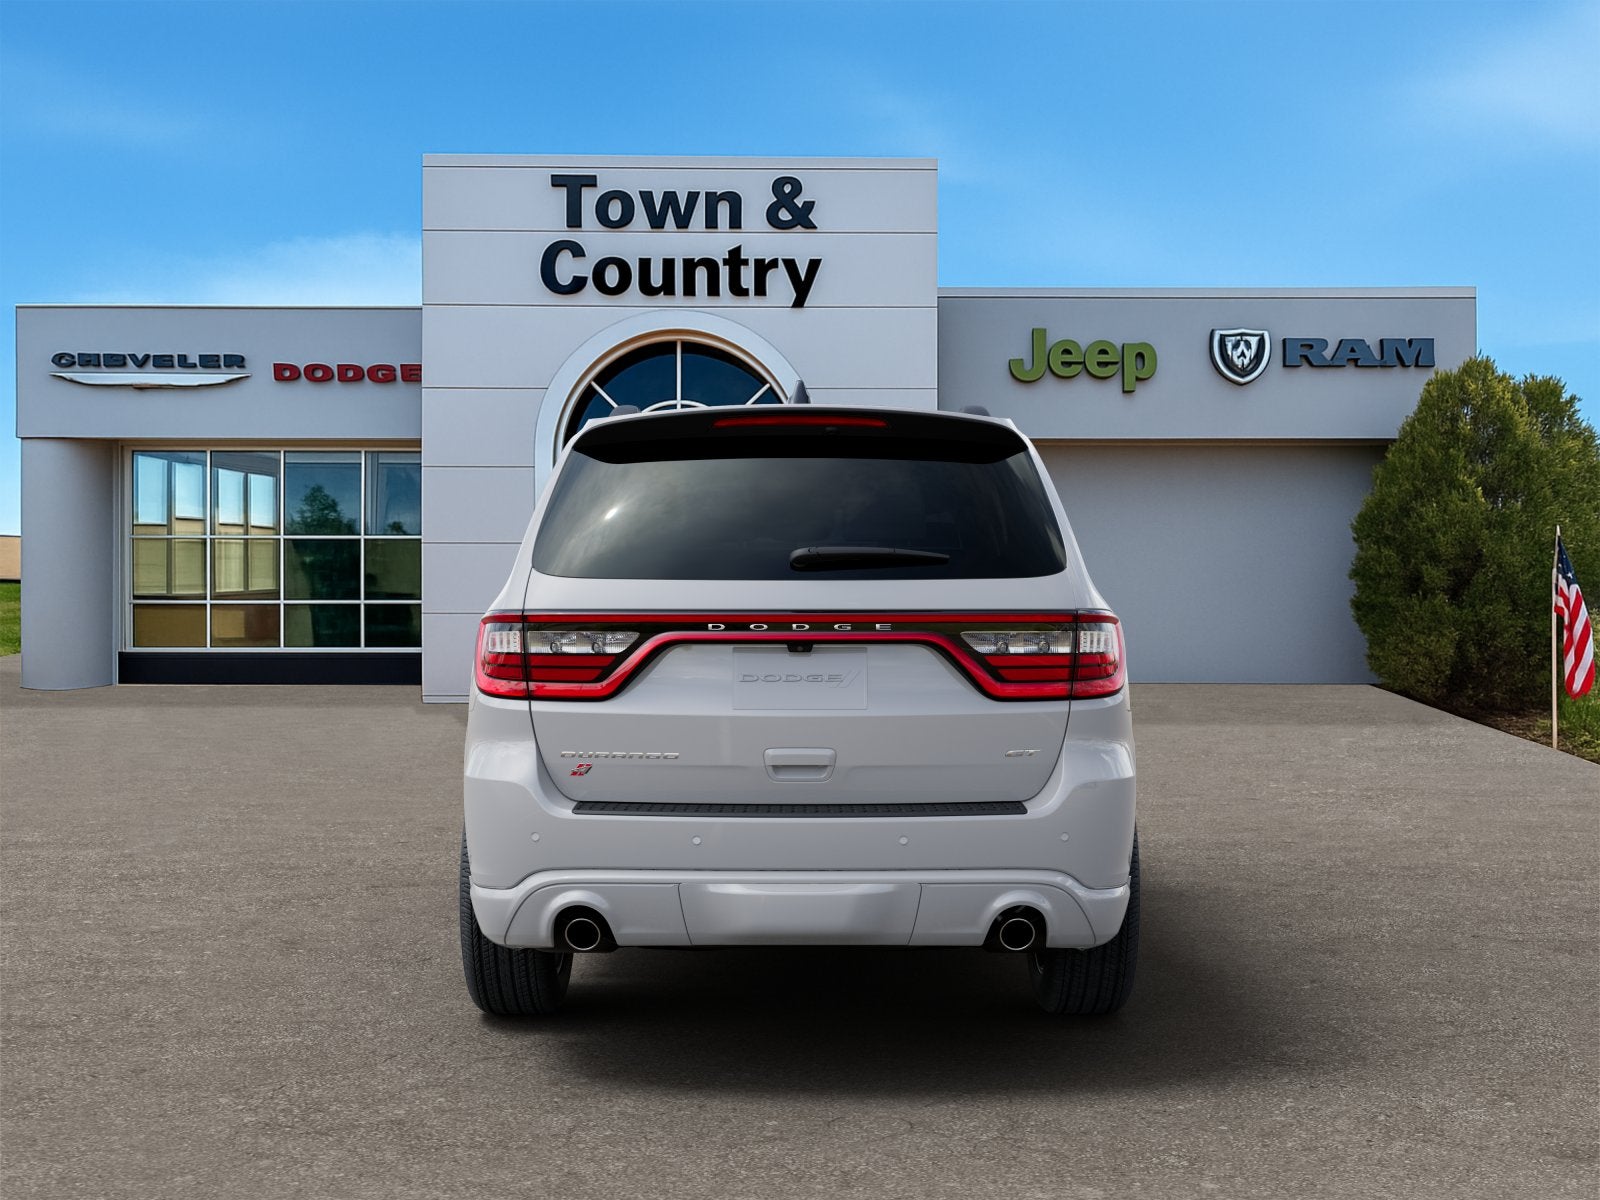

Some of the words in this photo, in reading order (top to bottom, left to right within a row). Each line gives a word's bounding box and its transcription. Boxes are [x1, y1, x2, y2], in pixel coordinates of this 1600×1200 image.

[550, 174, 742, 229] Town
[765, 176, 818, 230] &
[540, 239, 822, 308] Country
[1009, 328, 1157, 392] Jeep
[1282, 338, 1436, 368] RAM
[273, 363, 422, 383] DODGE
[707, 623, 892, 631] DODGE
[738, 673, 843, 683] DODGE
[560, 751, 680, 760] DURANGO
[1005, 749, 1041, 758] GT
